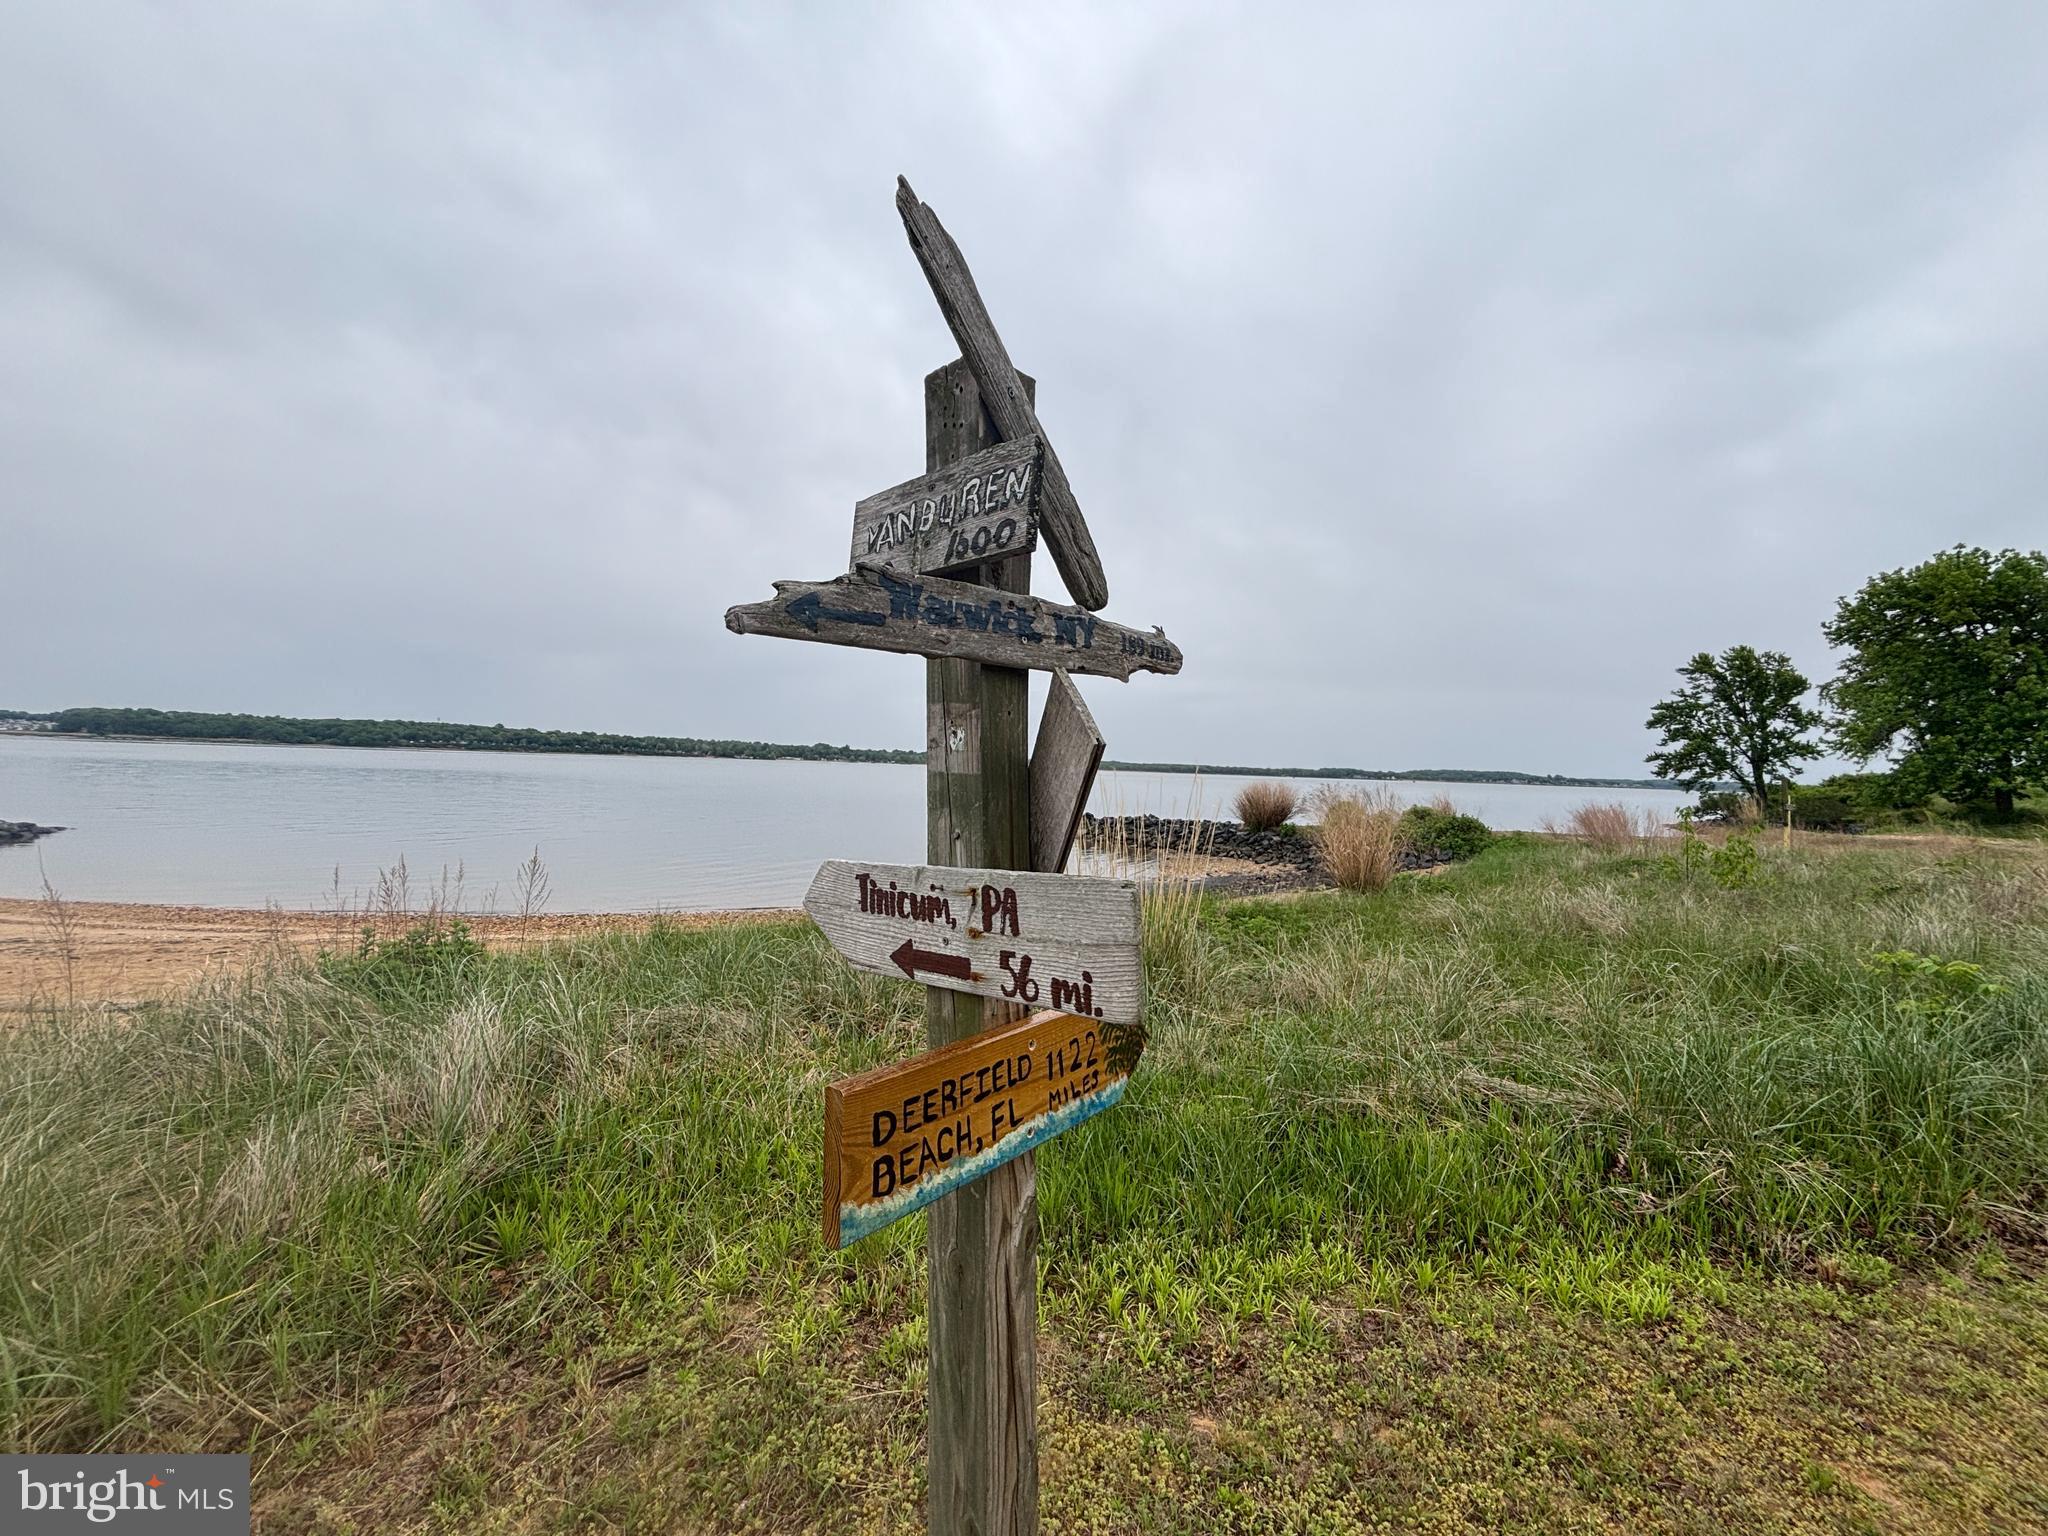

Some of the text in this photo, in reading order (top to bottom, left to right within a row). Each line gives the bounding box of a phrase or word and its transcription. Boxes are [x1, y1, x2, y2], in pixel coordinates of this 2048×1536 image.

[943, 517, 1017, 565] 1600
[1052, 611, 1096, 649] NY
[854, 872, 1020, 938] Tinicum, PA
[999, 950, 1104, 1018] 56 mi.
[1045, 1030, 1099, 1082] 1122
[872, 1053, 1032, 1148] DEERFIELD
[1049, 1068, 1100, 1111] MILES
[871, 1098, 1025, 1198] BEACH, FL
